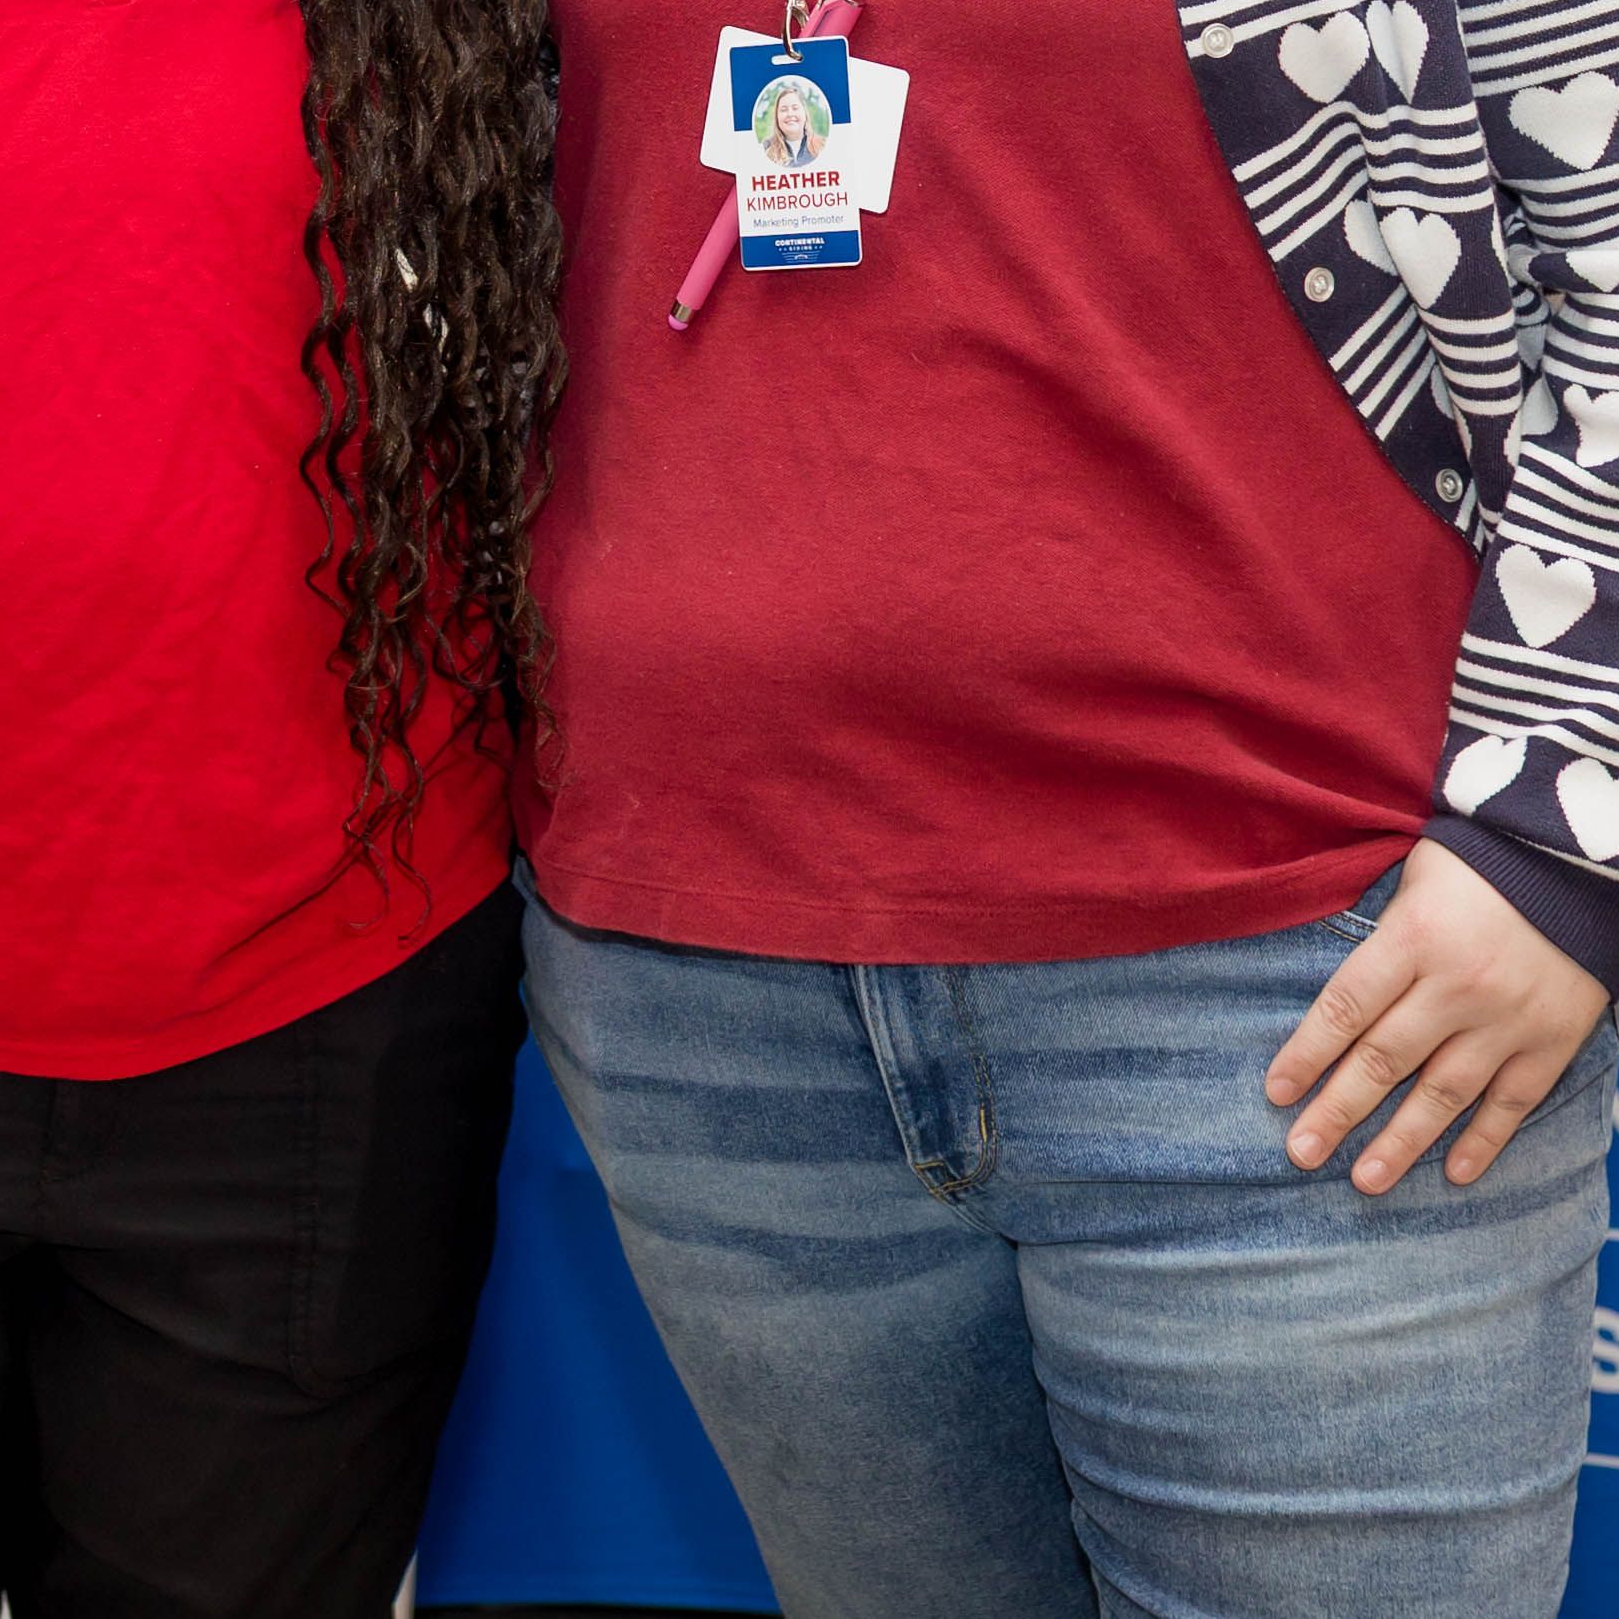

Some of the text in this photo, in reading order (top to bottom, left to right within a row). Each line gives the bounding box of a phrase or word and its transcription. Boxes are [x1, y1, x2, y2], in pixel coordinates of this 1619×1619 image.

[751, 170, 841, 191] HEATHER
[746, 191, 849, 213] KIMBROUGH
[753, 218, 799, 229] Marketing
